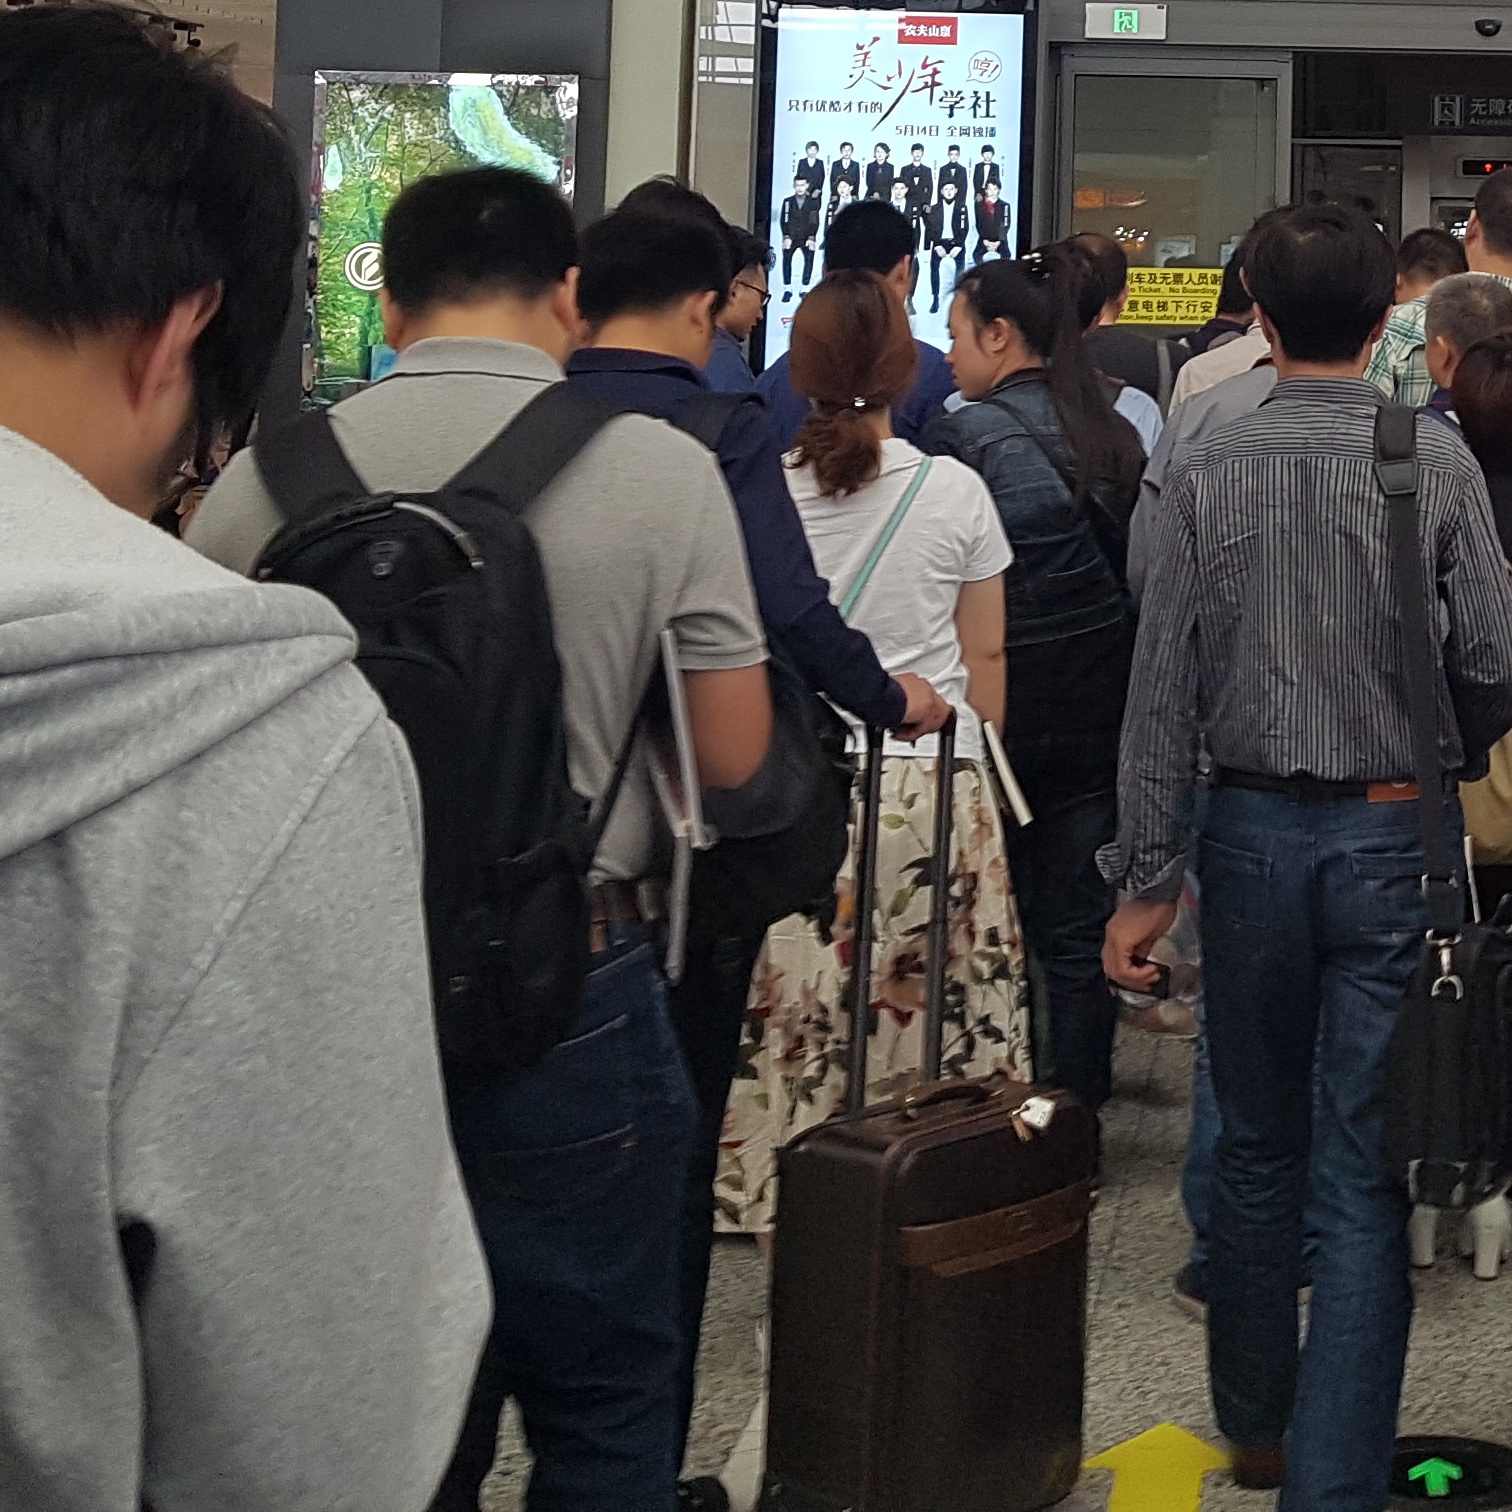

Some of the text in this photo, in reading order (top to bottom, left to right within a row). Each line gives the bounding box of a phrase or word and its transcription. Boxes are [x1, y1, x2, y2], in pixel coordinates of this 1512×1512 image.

[904, 24, 952, 37] 农夫山泉
[788, 99, 883, 113] 只有优酷才有的
[895, 125, 939, 136] 5月14日
